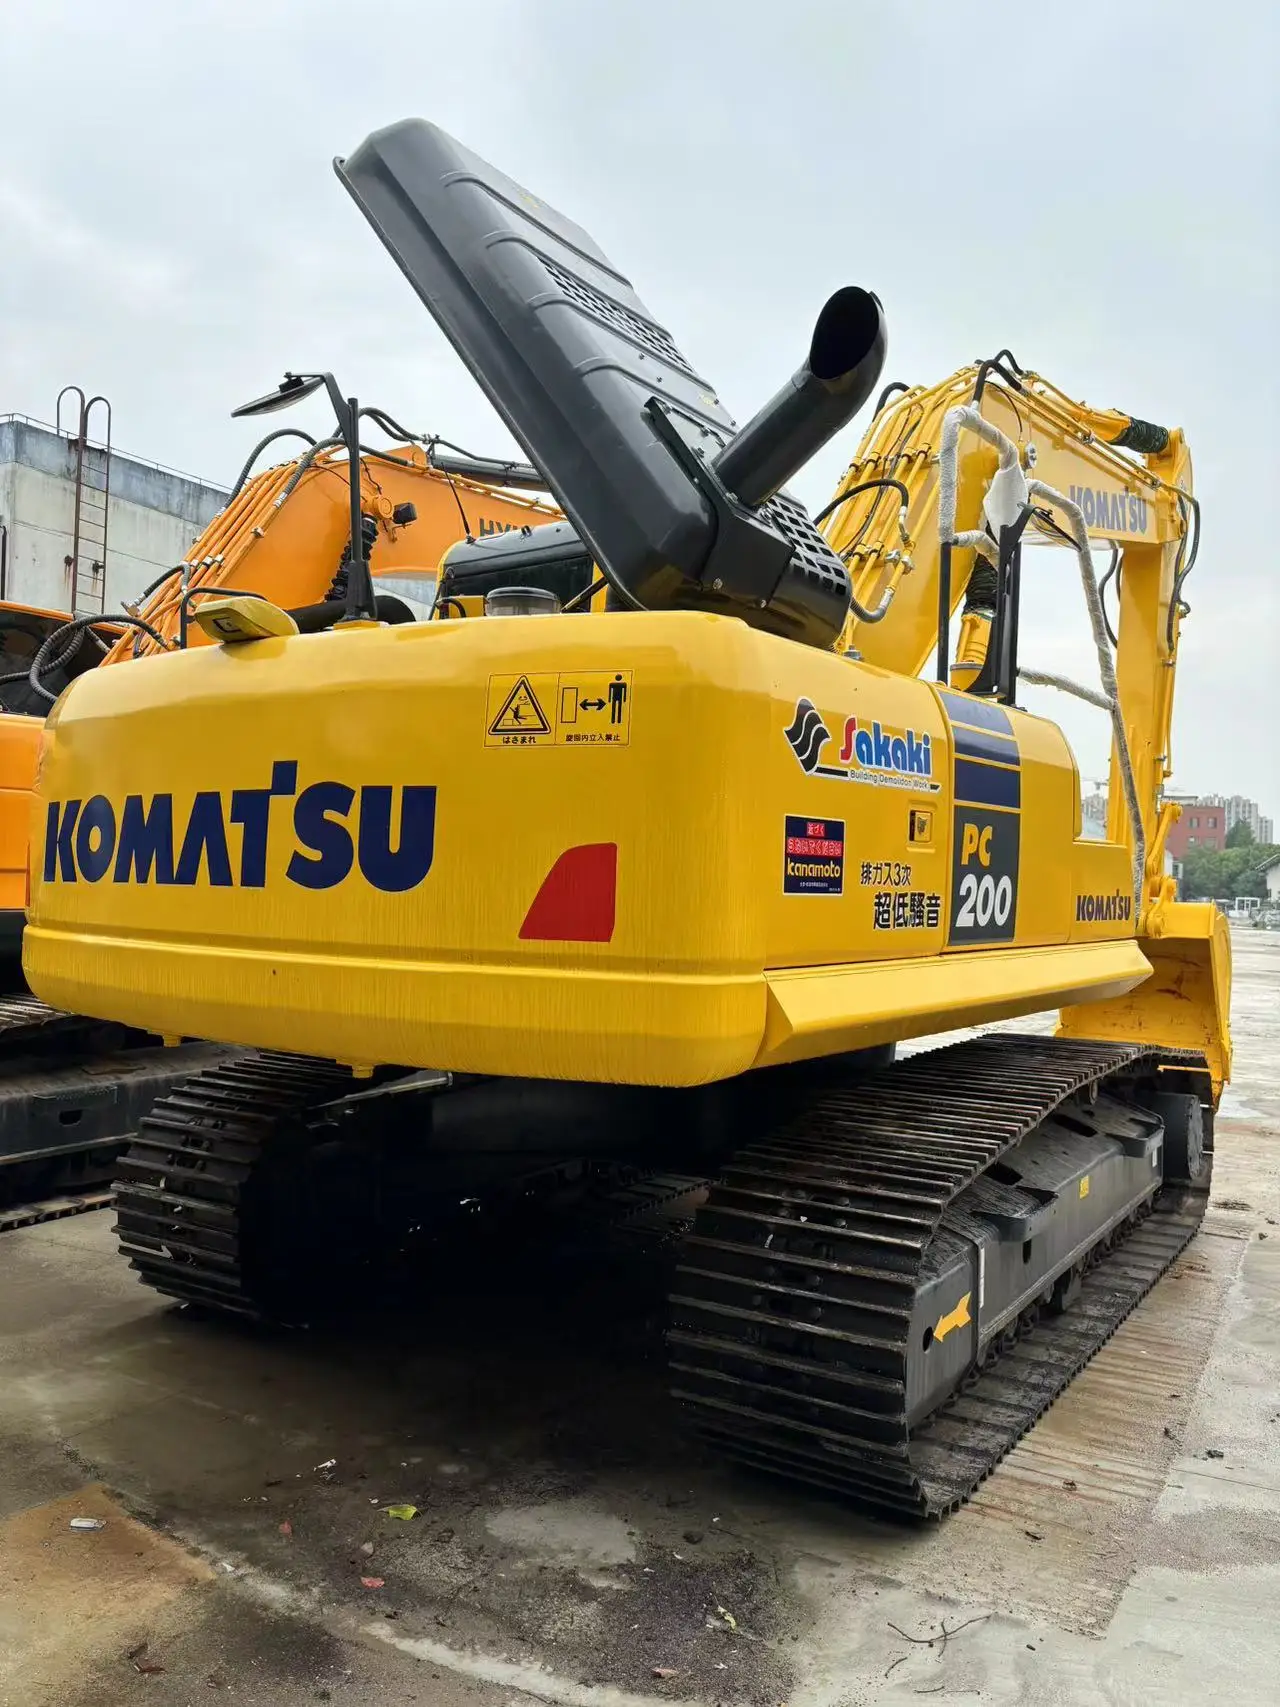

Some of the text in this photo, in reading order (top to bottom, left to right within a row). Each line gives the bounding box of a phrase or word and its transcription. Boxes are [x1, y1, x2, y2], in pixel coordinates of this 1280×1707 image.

[502, 735, 537, 744] はさまれ
[840, 715, 932, 777] Sakaki
[850, 770, 878, 783] Building
[43, 760, 438, 893] KOMATSU
[960, 823, 993, 867] PC
[787, 857, 841, 878] kanamoto
[860, 862, 912, 887] 排ガス3次
[873, 891, 941, 930] 超低騒音
[955, 873, 1012, 927] 200
[1075, 888, 1132, 922] KOMATSU
